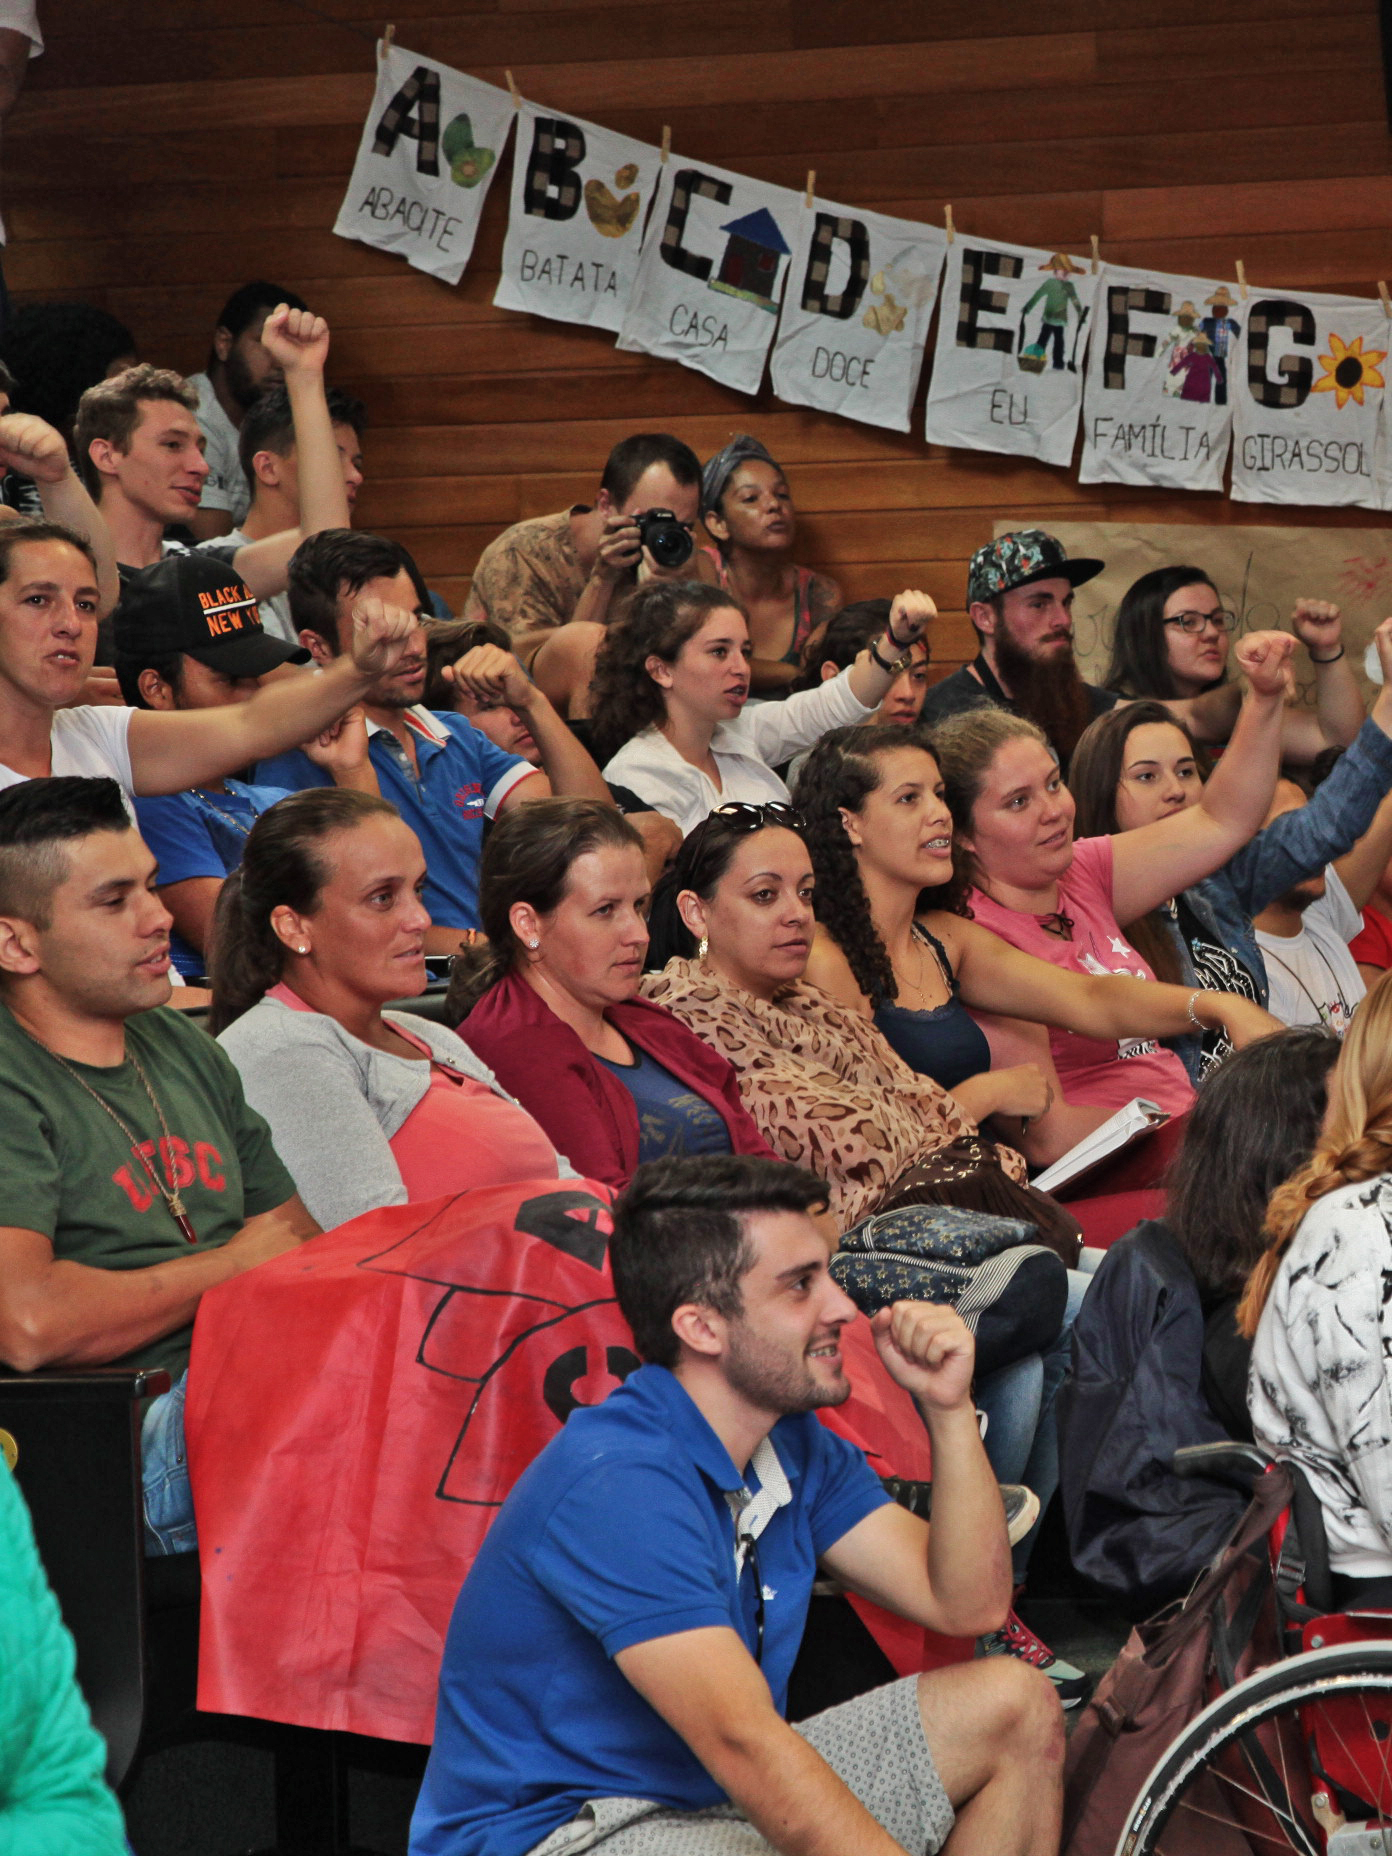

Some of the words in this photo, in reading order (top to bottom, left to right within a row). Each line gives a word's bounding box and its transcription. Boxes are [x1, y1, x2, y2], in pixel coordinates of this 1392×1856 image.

[372, 66, 441, 178] A
[524, 116, 587, 221] B
[659, 169, 733, 281] C
[520, 249, 617, 297] BATATA
[801, 212, 870, 320] D
[956, 248, 1024, 354] E
[669, 304, 728, 350] CASA
[1104, 286, 1172, 390] F
[812, 346, 875, 389] DOCE
[1247, 300, 1316, 409] G
[990, 389, 1028, 425] EU
[1093, 414, 1211, 461] FAMÍLIA
[1243, 433, 1371, 477] GIRASSOL
[198, 585, 242, 609] BLACK
[206, 610, 243, 637] NEW
